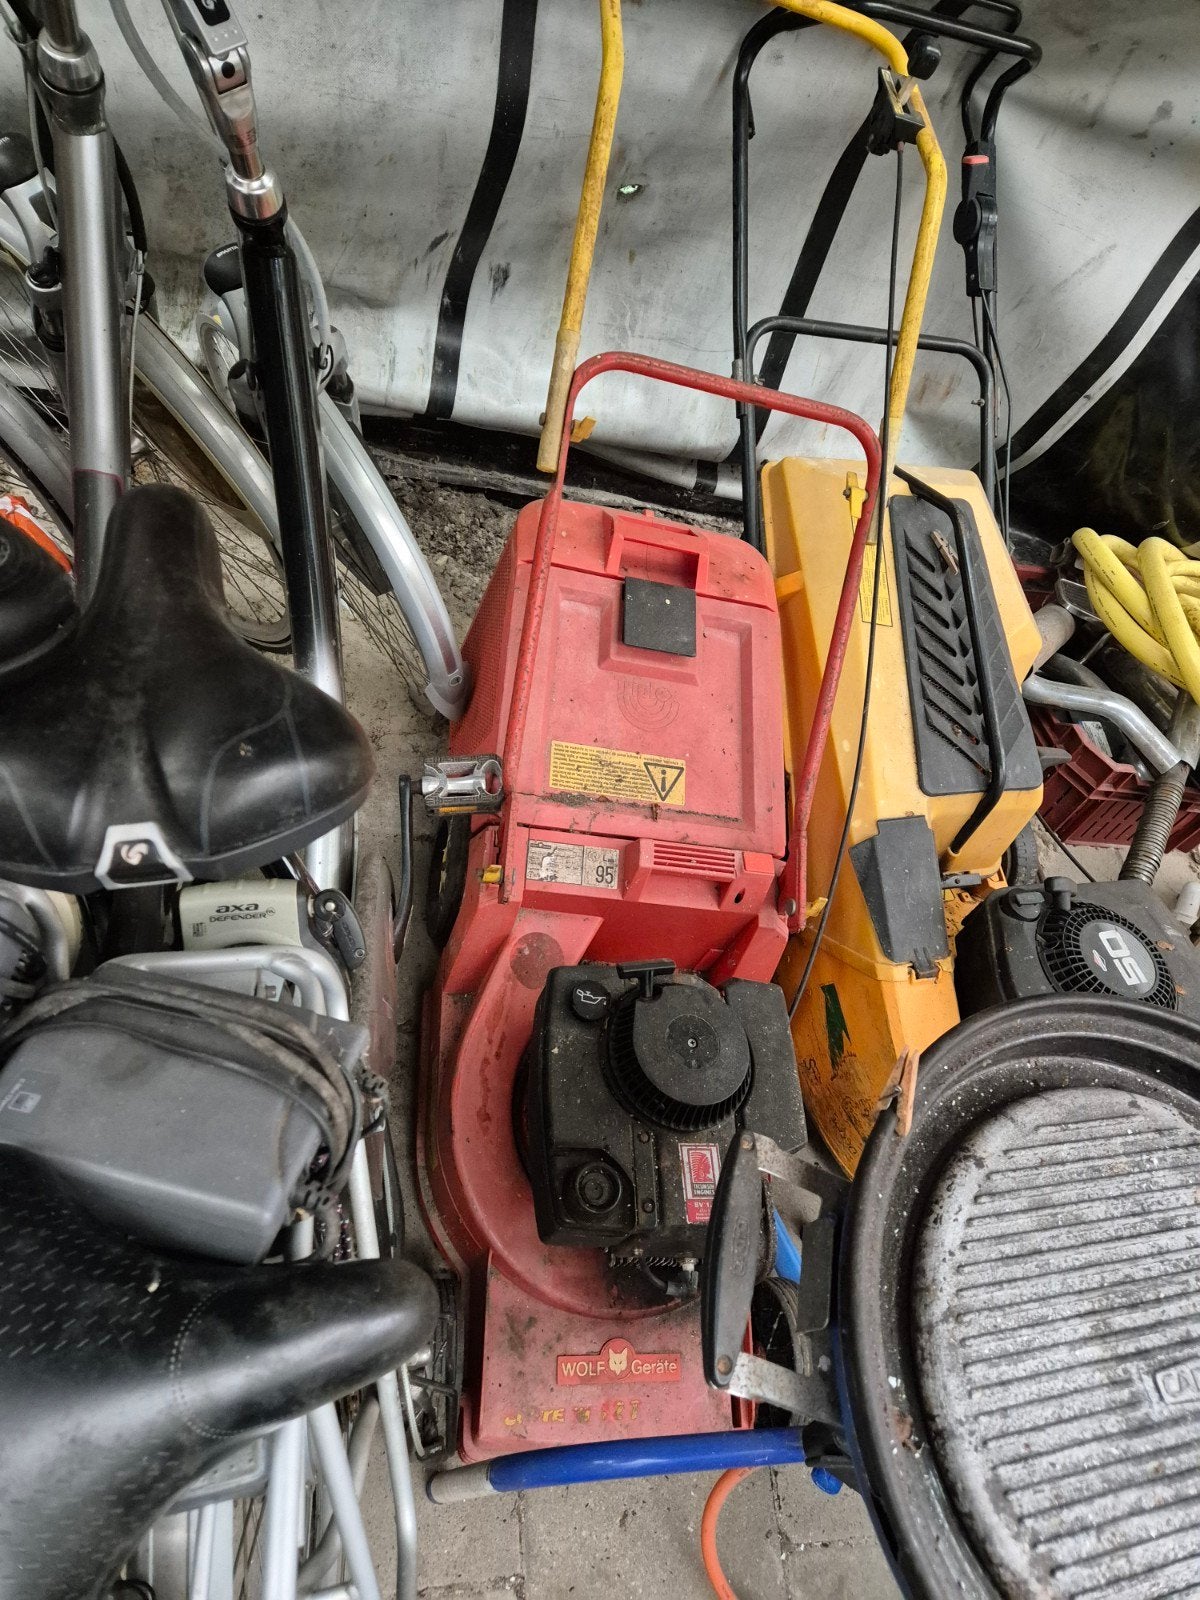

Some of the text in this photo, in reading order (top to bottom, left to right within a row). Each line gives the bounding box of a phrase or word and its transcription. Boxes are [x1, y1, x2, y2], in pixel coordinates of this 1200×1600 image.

[595, 865, 614, 884] 95
[215, 903, 260, 914] axa
[209, 913, 267, 923] DEFENDER
[562, 1359, 678, 1377] WOLF Geräte
